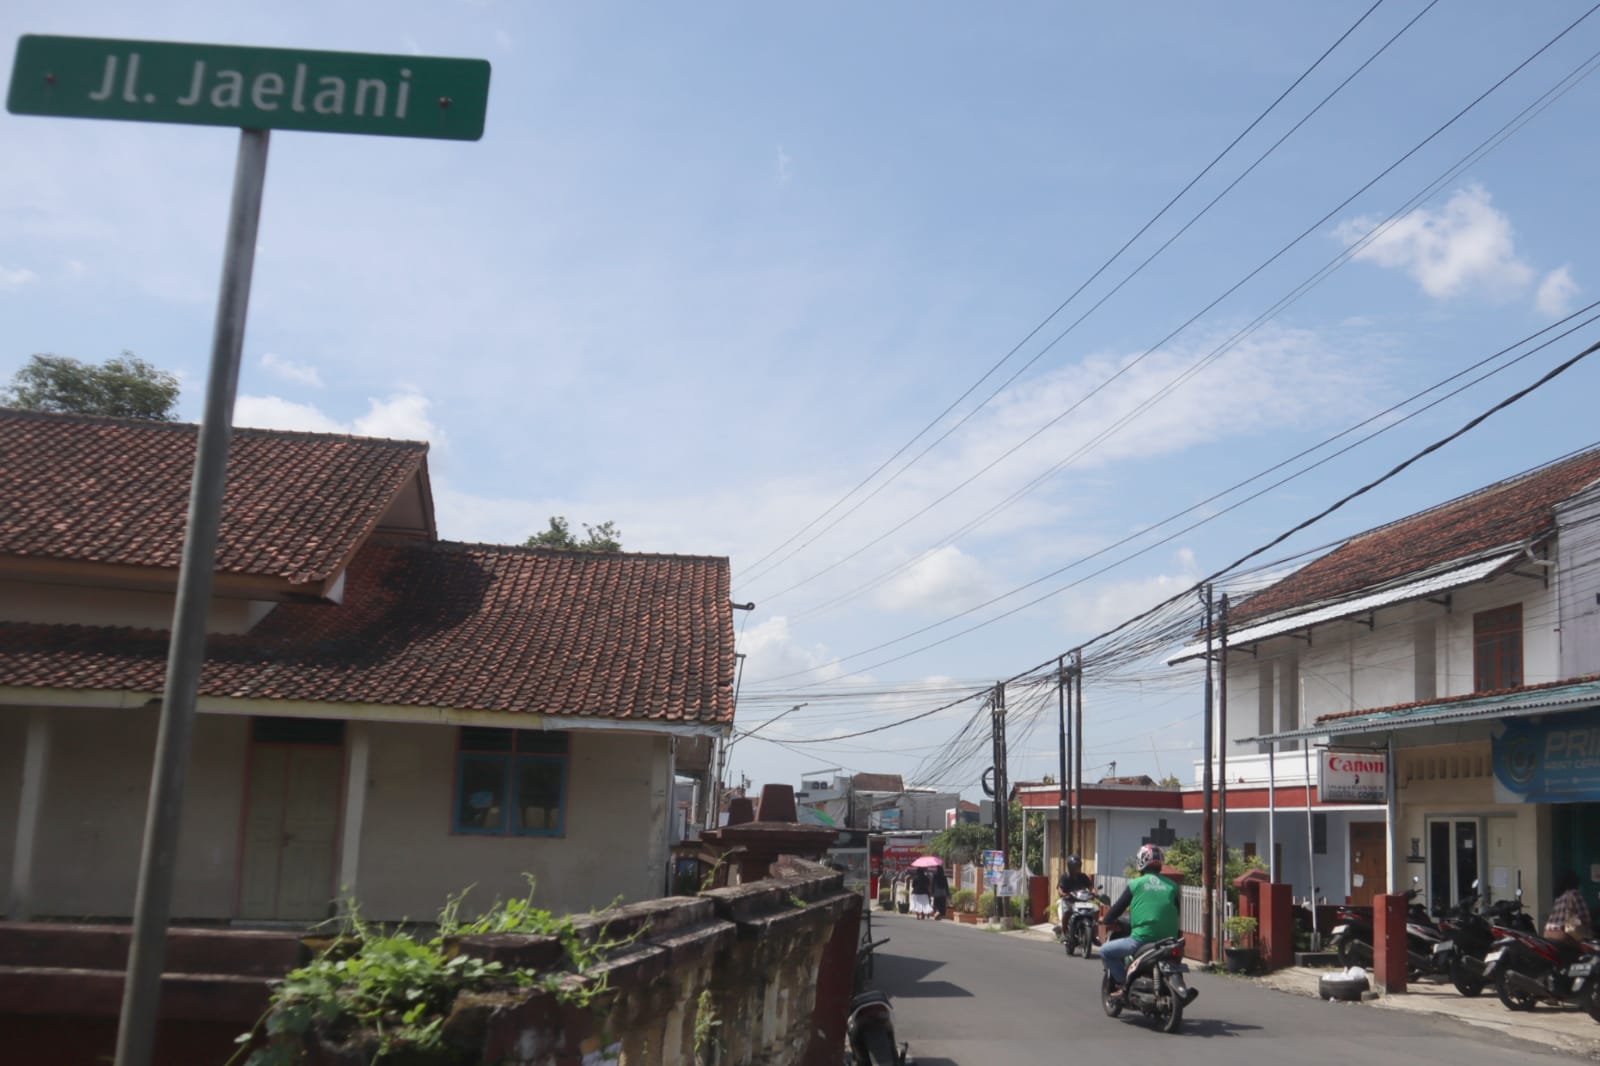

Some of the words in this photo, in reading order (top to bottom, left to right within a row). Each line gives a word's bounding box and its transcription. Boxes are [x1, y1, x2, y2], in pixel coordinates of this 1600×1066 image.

[88, 53, 156, 104] Jl.
[176, 60, 414, 119] Jaelani
[1328, 756, 1384, 773] Canon
